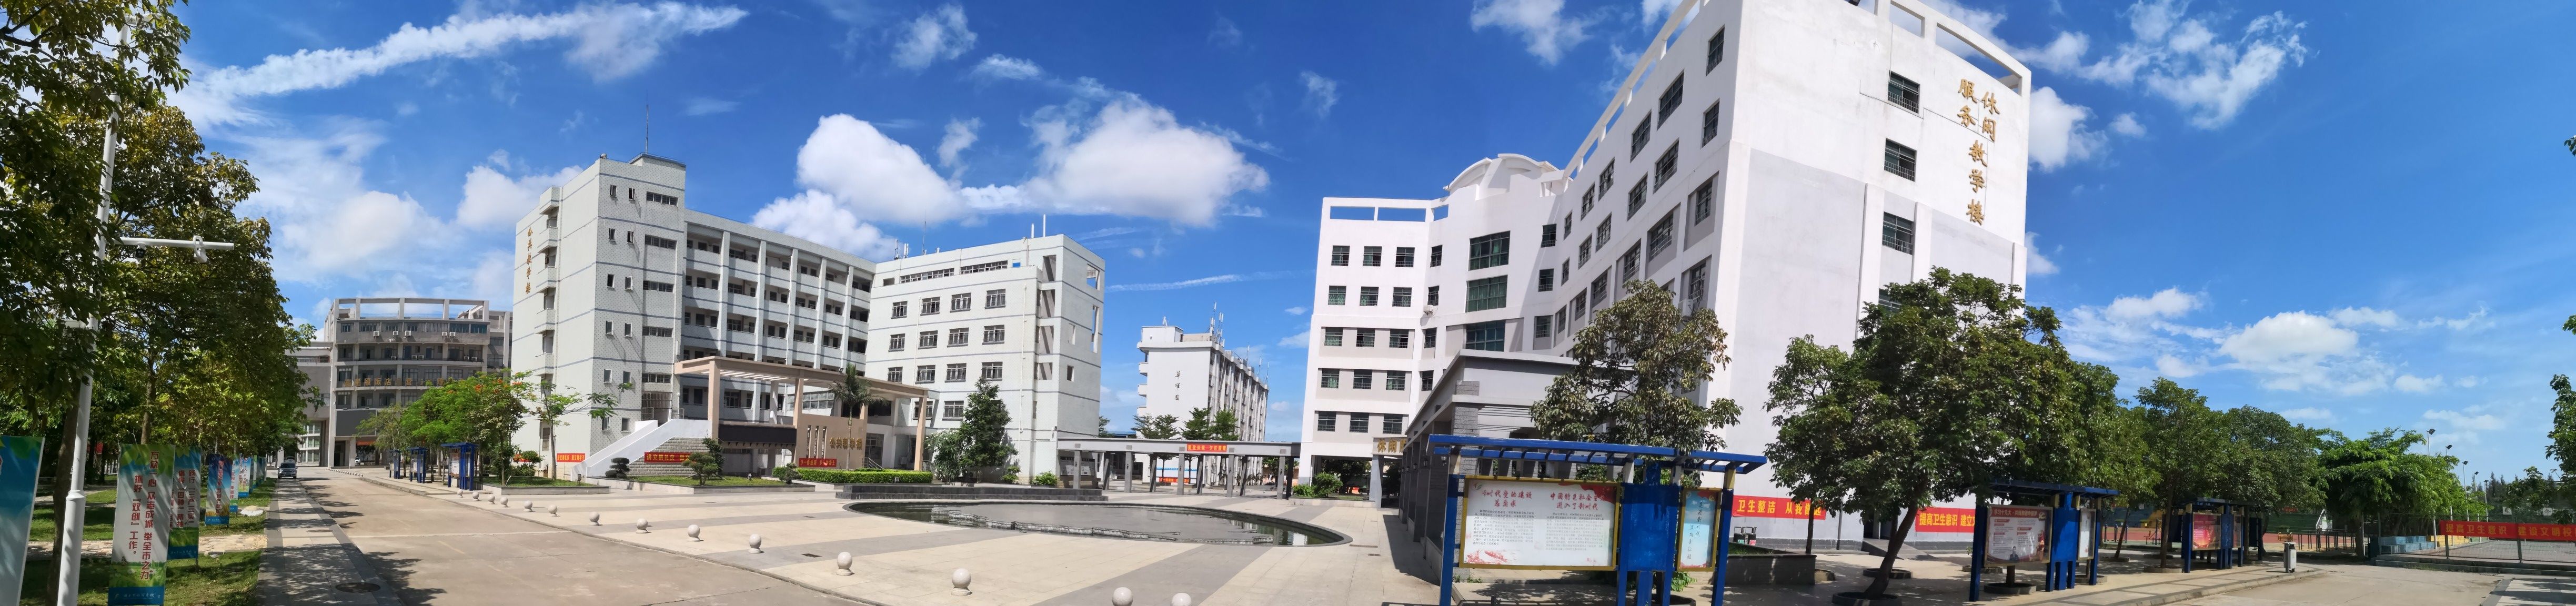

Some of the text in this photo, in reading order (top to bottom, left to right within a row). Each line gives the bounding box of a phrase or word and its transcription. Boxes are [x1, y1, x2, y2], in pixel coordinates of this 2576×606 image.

[1957, 78, 1978, 128] 服务
[1981, 90, 2001, 143] 休闲
[1966, 139, 1988, 226] 教学楼
[830, 437, 862, 450] 公共教学楼
[1550, 492, 1605, 502] 中国特色社会主义
[1737, 500, 1776, 514] 卫生整洁
[140, 451, 159, 580] 万众一心 众志成城 举全市之力
[1919, 513, 1958, 527] 提高卫生意识
[2446, 523, 2576, 537] 提高卫生意识 建设文明校
